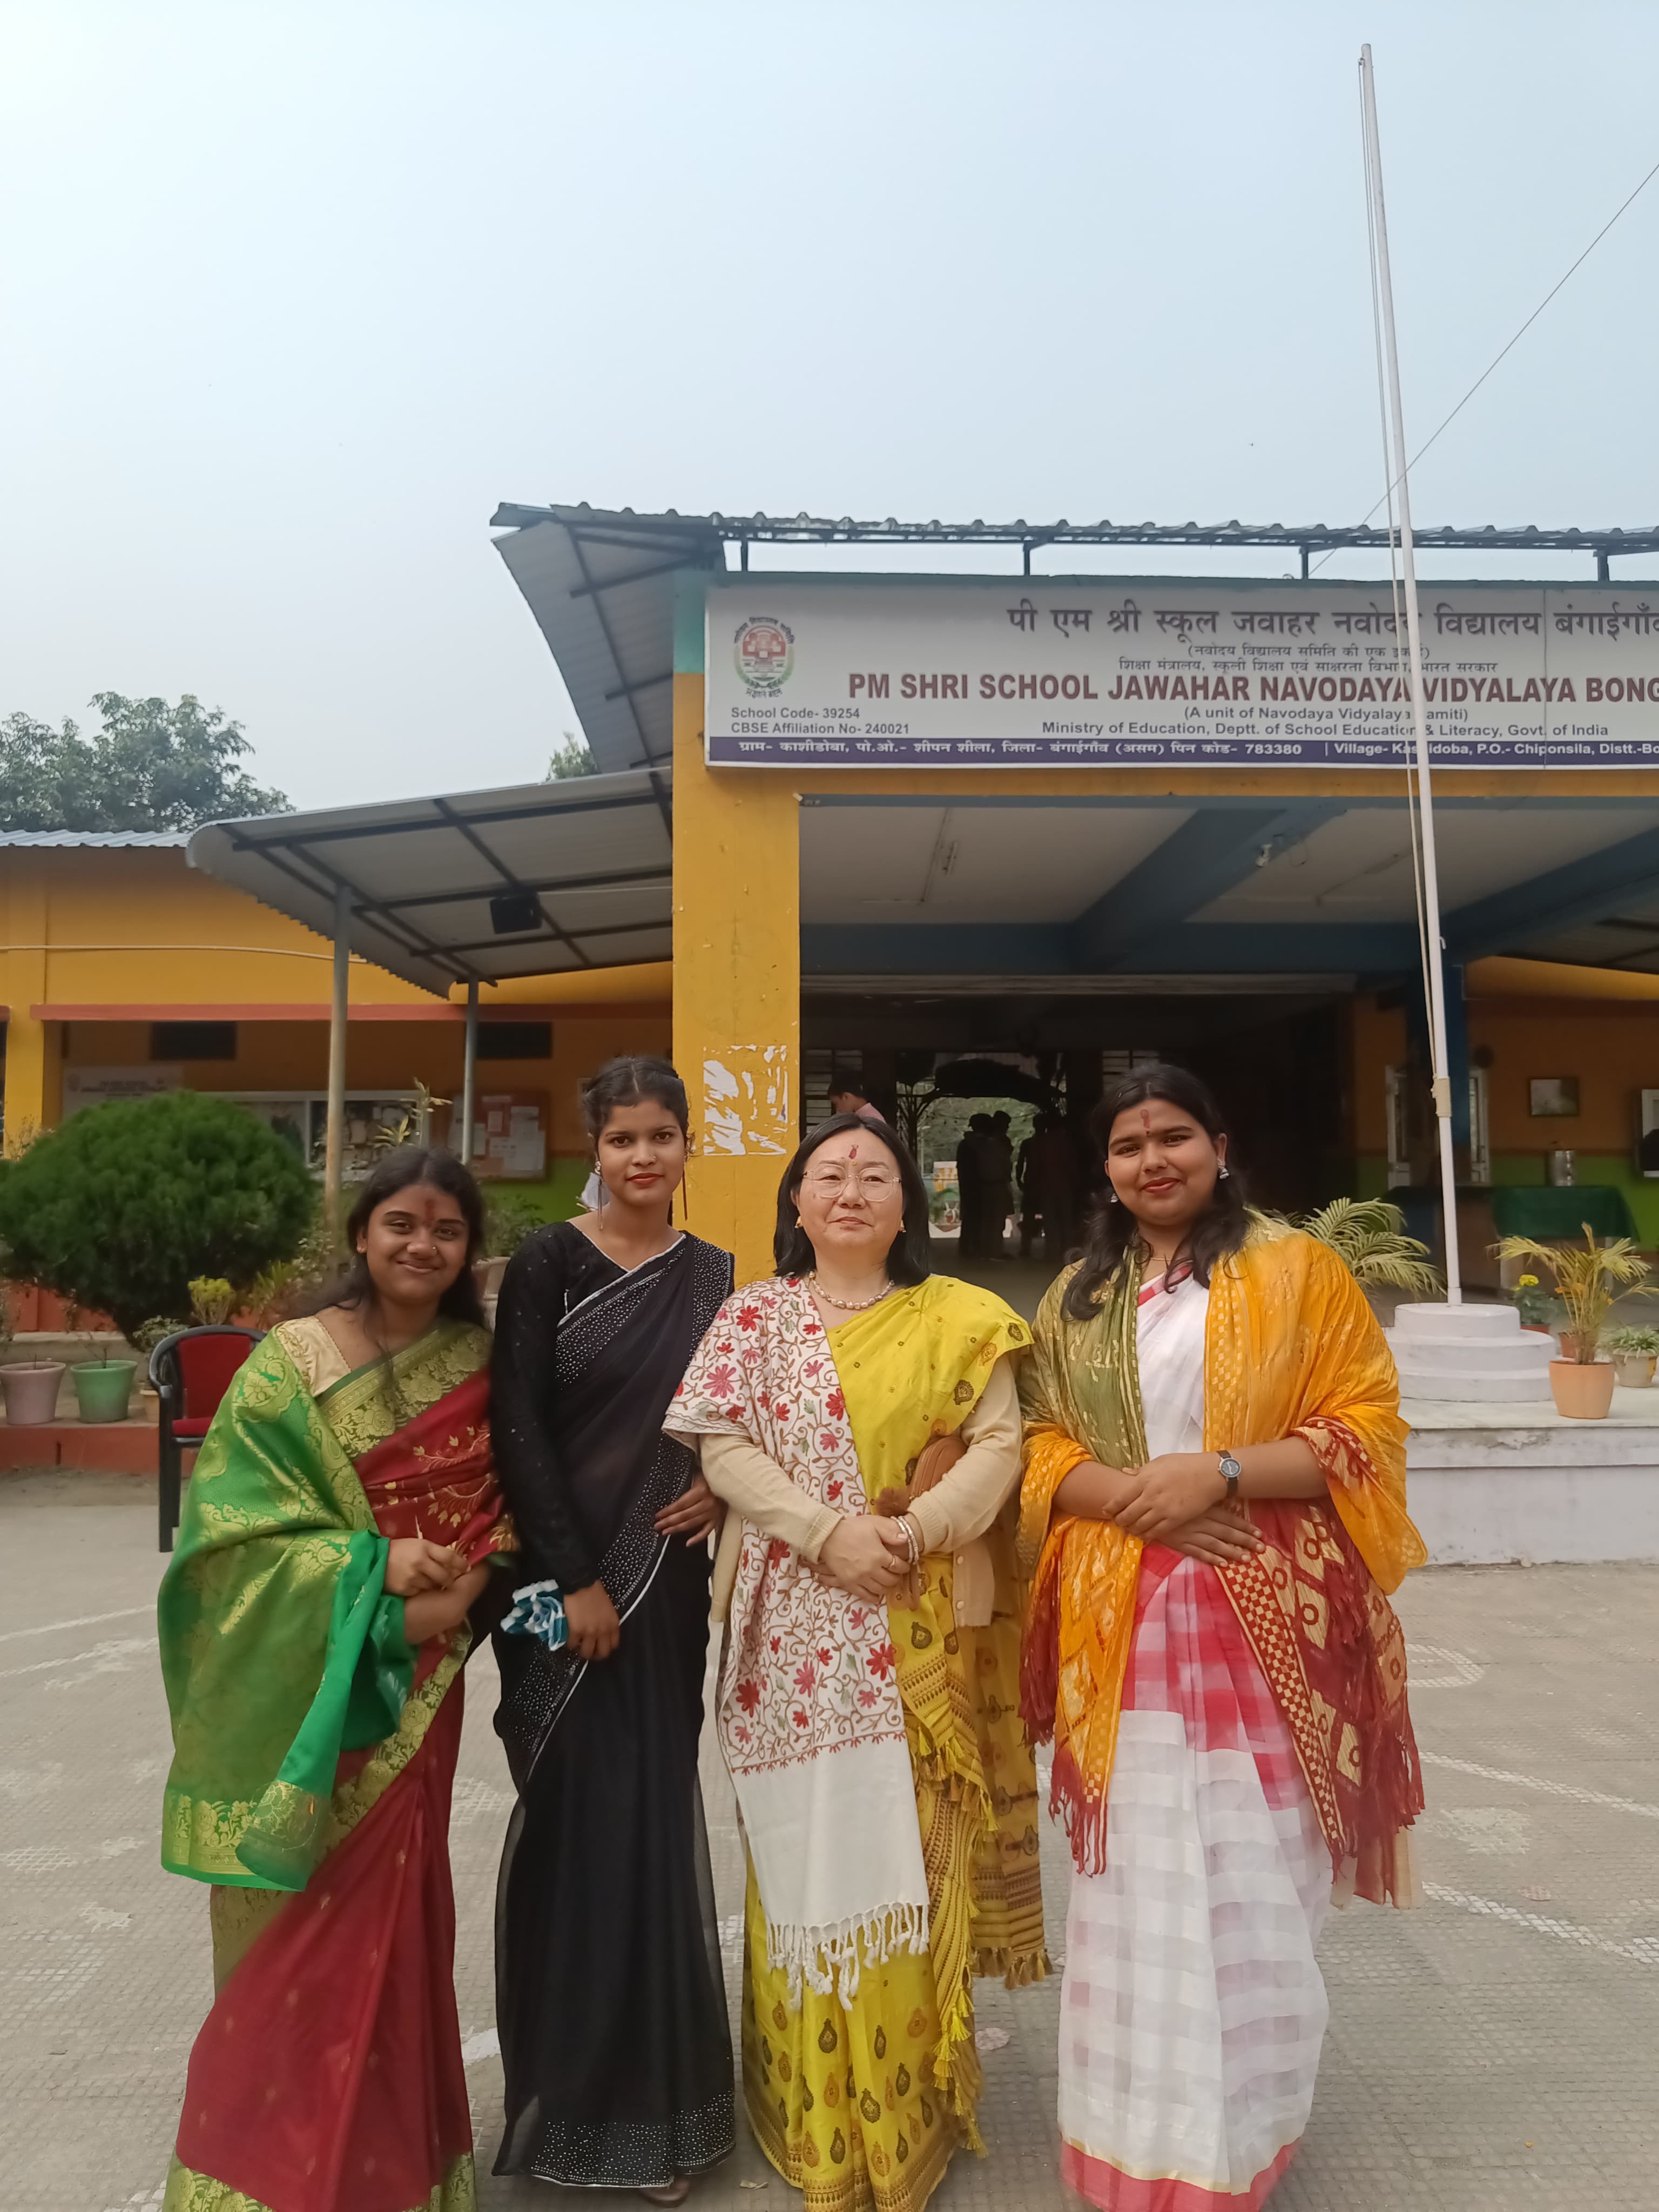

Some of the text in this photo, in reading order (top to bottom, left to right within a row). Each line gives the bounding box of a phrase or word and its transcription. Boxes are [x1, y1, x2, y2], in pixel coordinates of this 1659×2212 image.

[1007, 598, 1037, 631] पी
[1049, 610, 1092, 638] एम
[1107, 599, 1142, 632] श्री
[1154, 610, 1219, 643] स्कूल
[1231, 611, 1320, 637] जवाहर
[1331, 602, 1422, 637] नवोद
[1434, 603, 1541, 635] विद्यालय
[1188, 643, 1236, 658] (नवोदय
[1243, 642, 1292, 656] विद्यालय
[1298, 643, 1336, 657] समिति
[1343, 643, 1358, 656] की
[1365, 648, 1385, 659] एक
[1119, 656, 1151, 670] शिक्षा
[1212, 657, 1246, 673] स्कूली
[1253, 658, 1284, 671] शिक्षा
[1290, 659, 1308, 673] एवं
[1315, 662, 1363, 672] साक्षरता
[1456, 663, 1498, 672] सरकार
[848, 673, 890, 699] PM
[900, 673, 968, 699] SHRI
[979, 675, 1098, 700] SCHOOL
[1108, 675, 1250, 700] JAWAHAR
[1260, 676, 1412, 702] NAVODAYA
[1422, 677, 1576, 702] VIDYALAYA
[731, 707, 860, 719] School Code- 39254
[1184, 706, 1201, 720] (A
[1205, 707, 1234, 718] unit
[1239, 707, 1254, 719] of
[1259, 707, 1333, 722] Navodaya
[1426, 709, 1468, 722] amiti)
[731, 723, 909, 734] CBSE Affiliation No- 240021
[1042, 722, 1103, 736] Ministry
[1109, 722, 1124, 733] of
[1129, 723, 1210, 736] Education,
[1216, 723, 1260, 737] Deptt.
[1265, 723, 1280, 734] of
[1285, 724, 1337, 735] School
[1426, 725, 1434, 736] &
[1440, 725, 1502, 738] Literacy,
[1508, 725, 1547, 736] Govt.
[1553, 725, 1568, 736] of
[1572, 725, 1608, 736] India
[1001, 740, 1043, 753] जिला-
[1115, 742, 1164, 755] (असम)
[1170, 741, 1196, 753] पिन
[1202, 741, 1237, 754] कोड-
[1244, 744, 1302, 755] 783380
[1334, 743, 1388, 756] Village-
[1392, 743, 1473, 756] Kasidoba,
[1514, 743, 1595, 756] Chiponsila,
